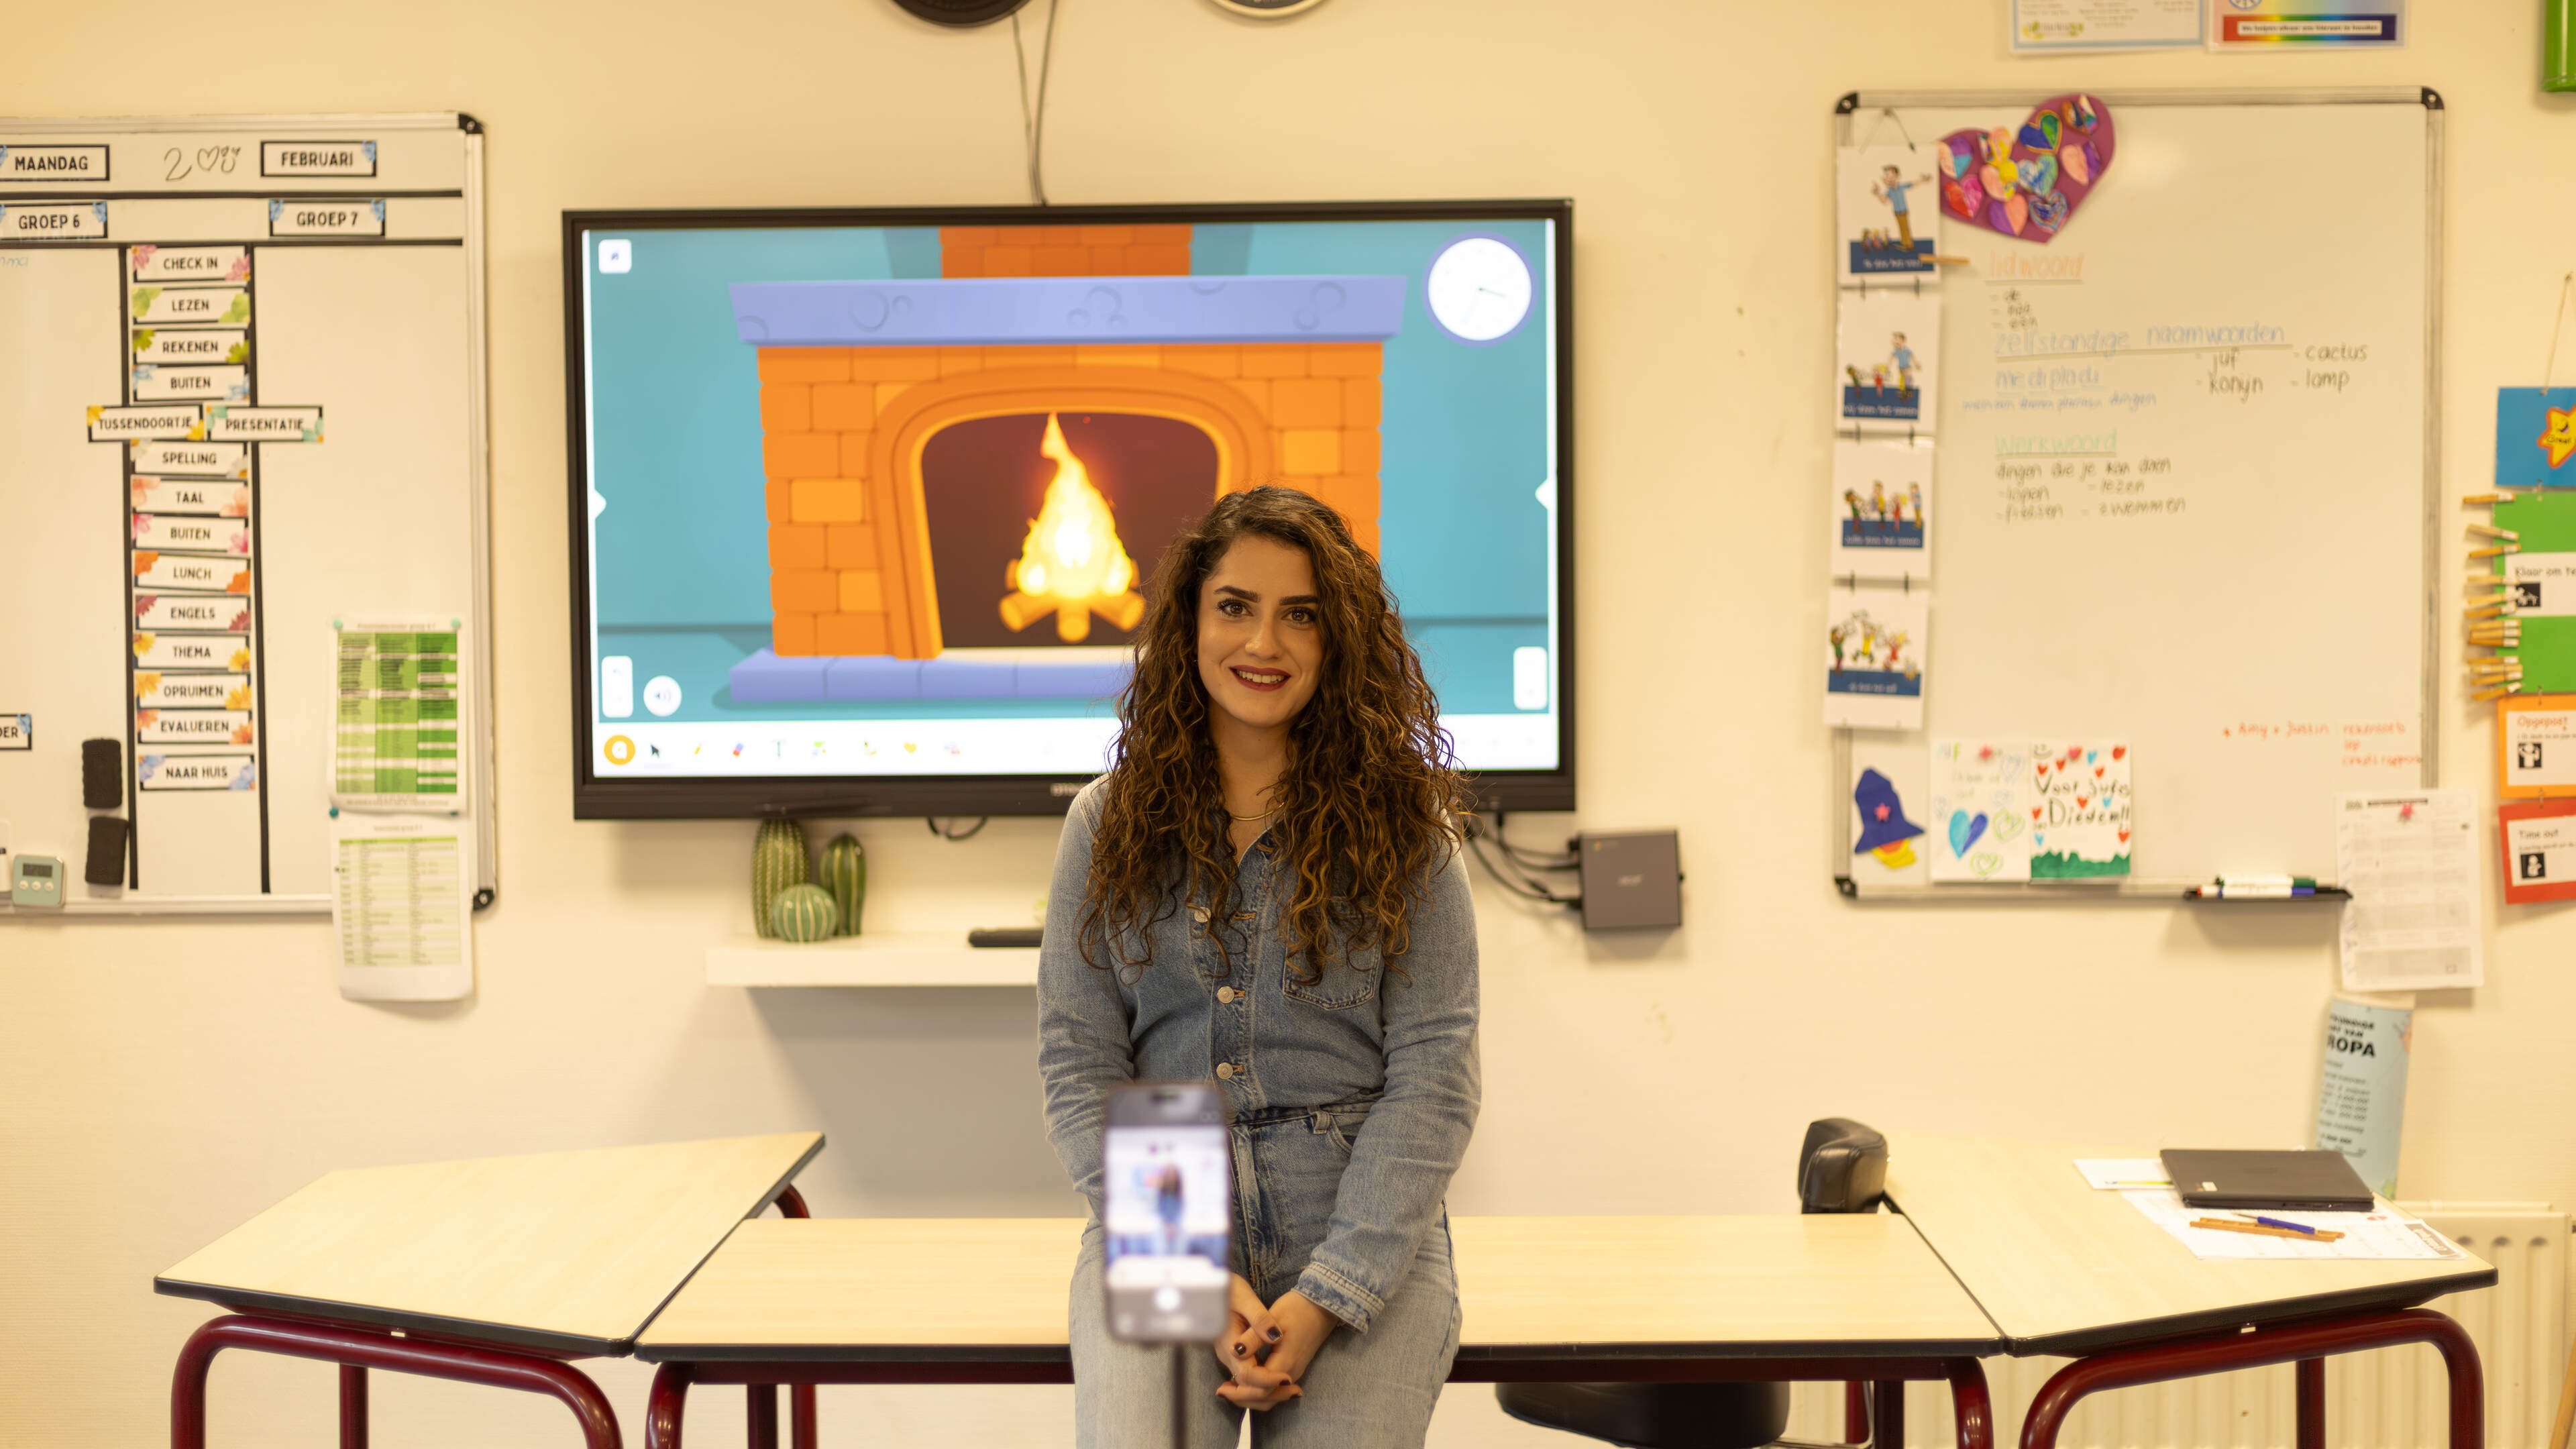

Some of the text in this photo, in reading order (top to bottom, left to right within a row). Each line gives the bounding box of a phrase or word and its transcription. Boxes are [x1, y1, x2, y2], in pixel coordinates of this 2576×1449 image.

[14, 155, 89, 171] MAANDAG
[281, 151, 354, 167] FEBRUARI
[18, 214, 80, 230] GROEP 6
[297, 211, 358, 227] GROEP 7
[163, 257, 218, 270] CHECK IN
[171, 299, 210, 312] LEZEN
[162, 340, 219, 354] REKENEN
[2304, 341, 2369, 362] cactus
[170, 376, 211, 390] BUITEN
[98, 416, 193, 430] TUSSENDOORTJE
[225, 417, 305, 431] PRESENTATIE
[162, 451, 217, 465] SPELLING
[176, 491, 204, 504] TAAL
[170, 527, 211, 540] BUITEN
[173, 567, 212, 580] LUNCH
[170, 606, 215, 620] ENGELS
[173, 645, 211, 658] THEMA
[163, 685, 223, 698] OPRUIMEN
[160, 720, 229, 733] EVALUEREN
[166, 765, 228, 779] NAAR HUIS
